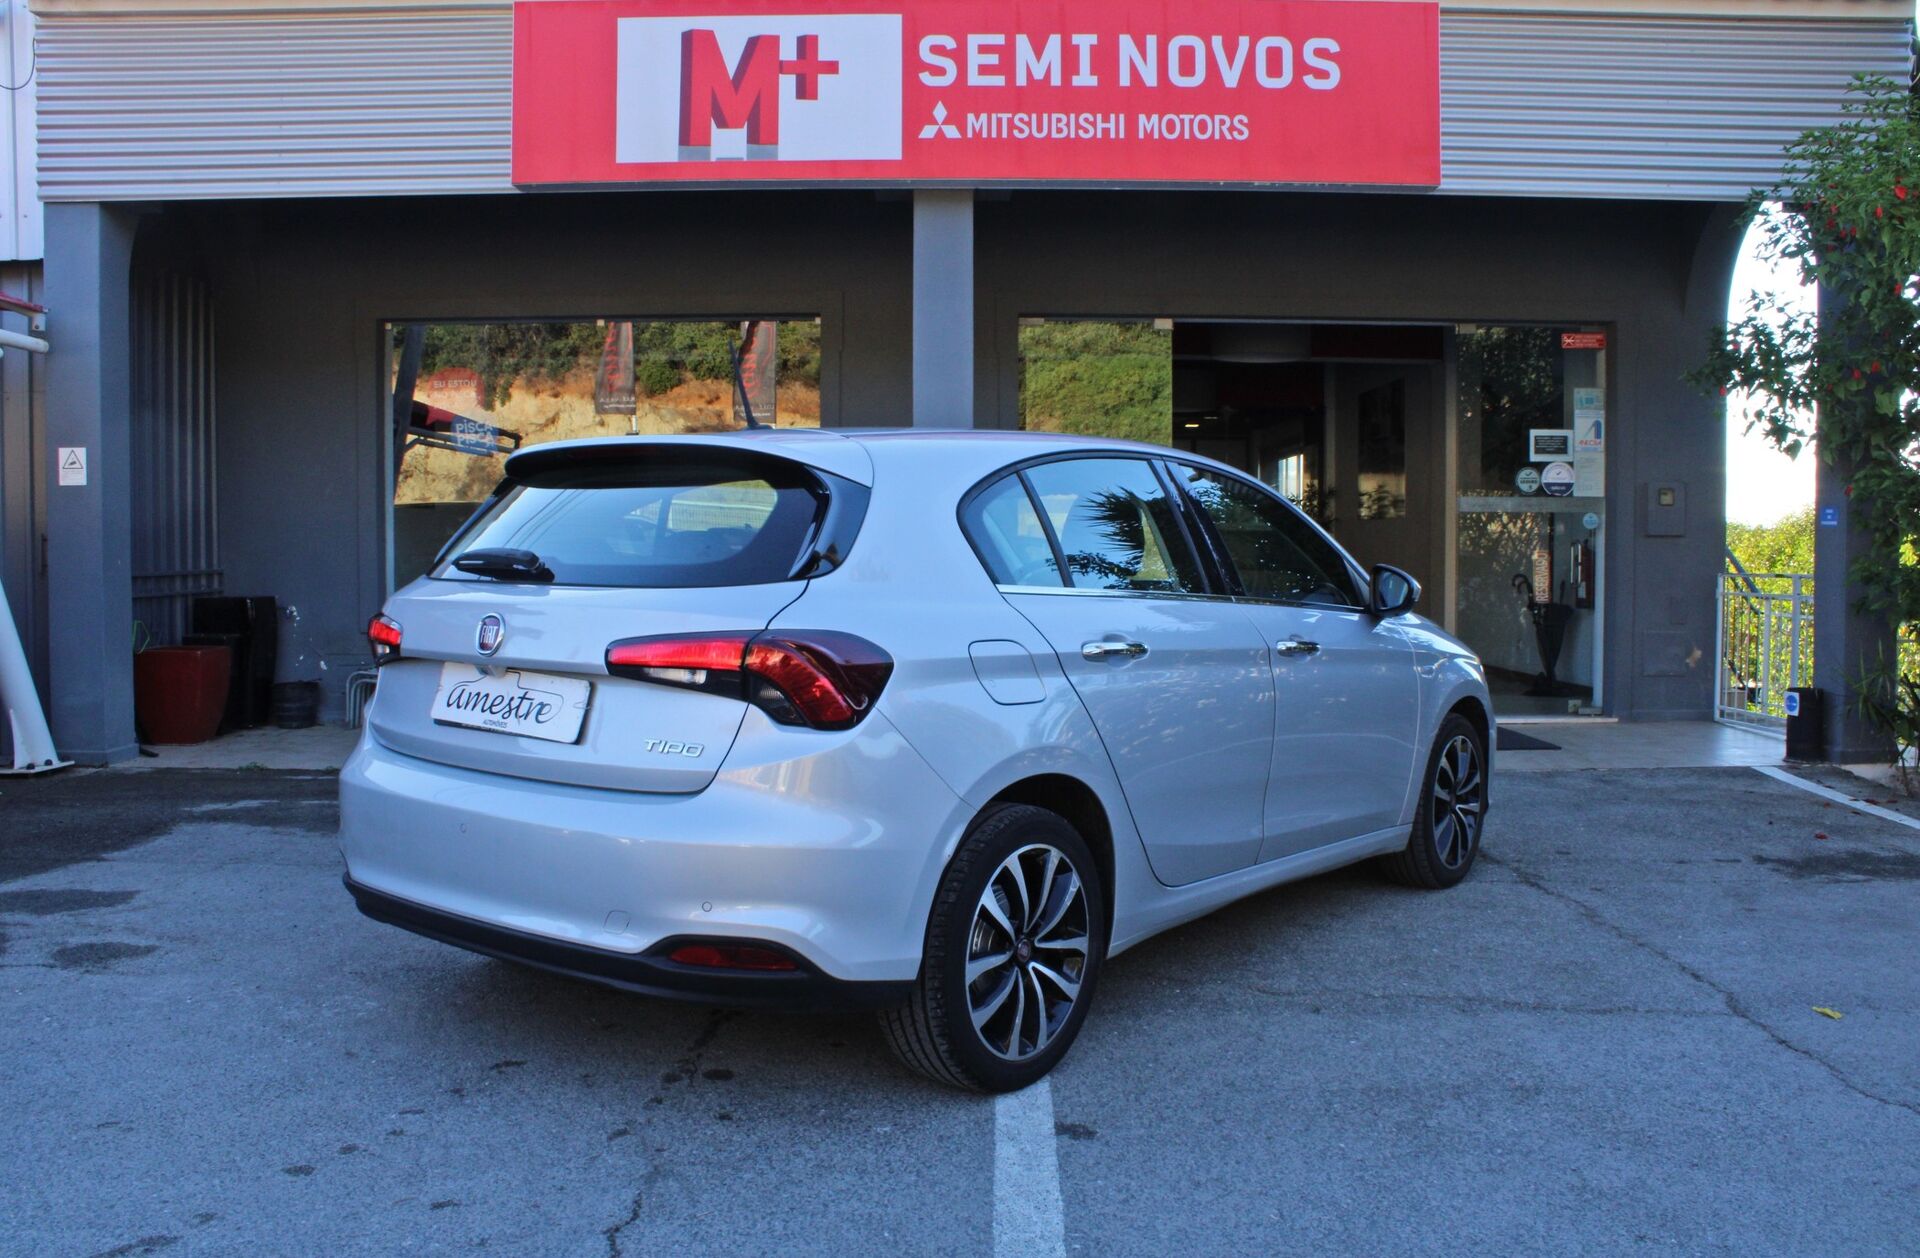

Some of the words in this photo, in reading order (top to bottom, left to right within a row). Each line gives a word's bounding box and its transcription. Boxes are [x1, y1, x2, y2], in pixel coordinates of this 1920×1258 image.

[918, 33, 1099, 87] SEMI
[1118, 34, 1342, 90] NOVOS
[966, 112, 1126, 139] MITSUBISHI
[1138, 113, 1250, 141] MOTORS
[1535, 550, 1549, 601] RESERVADO
[480, 625, 498, 643] FIAT
[644, 738, 705, 758] TIPO
